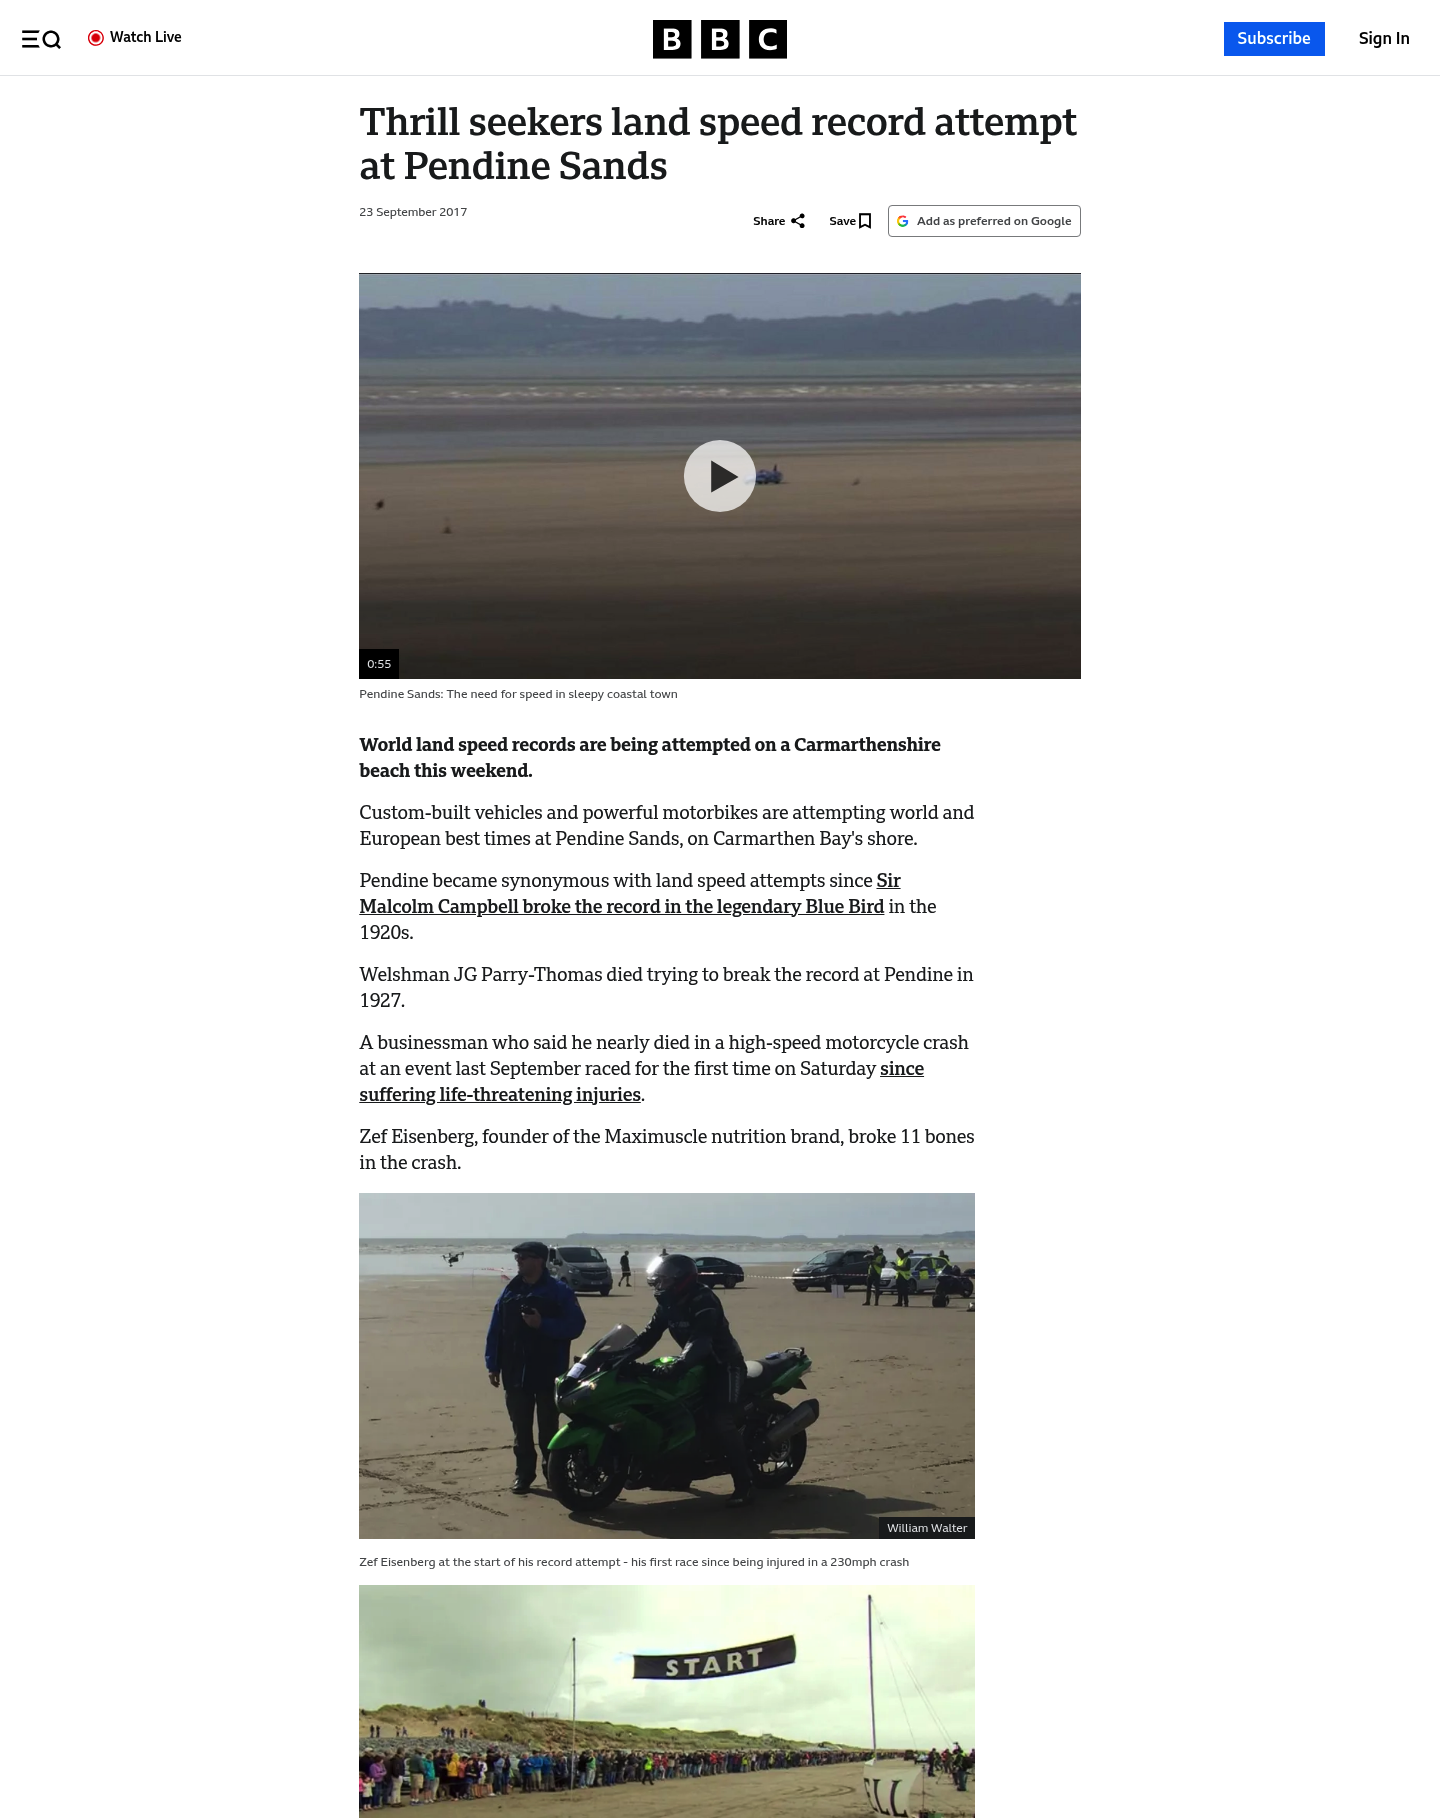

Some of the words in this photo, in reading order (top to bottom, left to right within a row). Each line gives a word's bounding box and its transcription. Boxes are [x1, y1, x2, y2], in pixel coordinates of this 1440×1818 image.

[109, 30, 152, 43] Watch
[155, 30, 182, 43] Live
[1237, 30, 1311, 45] Subscribe
[1358, 30, 1392, 49] Sign
[1396, 31, 1410, 45] In
[359, 106, 461, 136] Thrill
[469, 106, 603, 137] seekers
[611, 106, 691, 137] land
[699, 106, 804, 145] speed
[811, 106, 927, 137] record
[934, 108, 1078, 145] attempt
[359, 152, 396, 181] at
[404, 150, 551, 181] Pendine
[559, 150, 668, 181] Sands
[359, 207, 374, 217] 23
[376, 207, 437, 220] September
[439, 207, 468, 217] 2017
[753, 216, 786, 226] Share
[829, 216, 857, 226] Save
[916, 216, 941, 226] Add
[942, 218, 956, 226] as
[958, 216, 1011, 229] preferred
[1013, 218, 1029, 226] on
[1030, 216, 1072, 229] Google
[359, 689, 405, 699] Pendine
[406, 689, 444, 699] Sands:
[445, 689, 468, 699] The
[470, 689, 498, 699] need
[500, 689, 518, 699] for
[519, 689, 553, 702] speed
[555, 689, 566, 699] in
[568, 689, 605, 702] sleepy
[606, 689, 648, 699] coastal
[649, 689, 678, 699] town
[358, 736, 413, 752] World
[415, 736, 455, 752] land
[458, 736, 509, 756] speed
[511, 736, 576, 752] records
[579, 740, 607, 752] are
[609, 736, 659, 756] being
[661, 736, 752, 756] attempted
[754, 740, 778, 752] on
[780, 740, 792, 752] a
[793, 736, 942, 752] Carmarthenshire
[358, 762, 411, 778] beach
[413, 762, 448, 778] this
[449, 762, 533, 778] weekend.
[359, 804, 472, 820] Custom-built
[473, 804, 543, 820] vehicles
[546, 804, 579, 820] and
[582, 804, 659, 824] powerful
[662, 804, 759, 820] motorbikes
[762, 808, 789, 820] are
[792, 804, 887, 824] attempting
[888, 804, 939, 820] world
[942, 804, 975, 820] and
[360, 924, 414, 940] 1920s.
[360, 992, 405, 1008] 1927.
[666, 1647, 763, 1677] START
